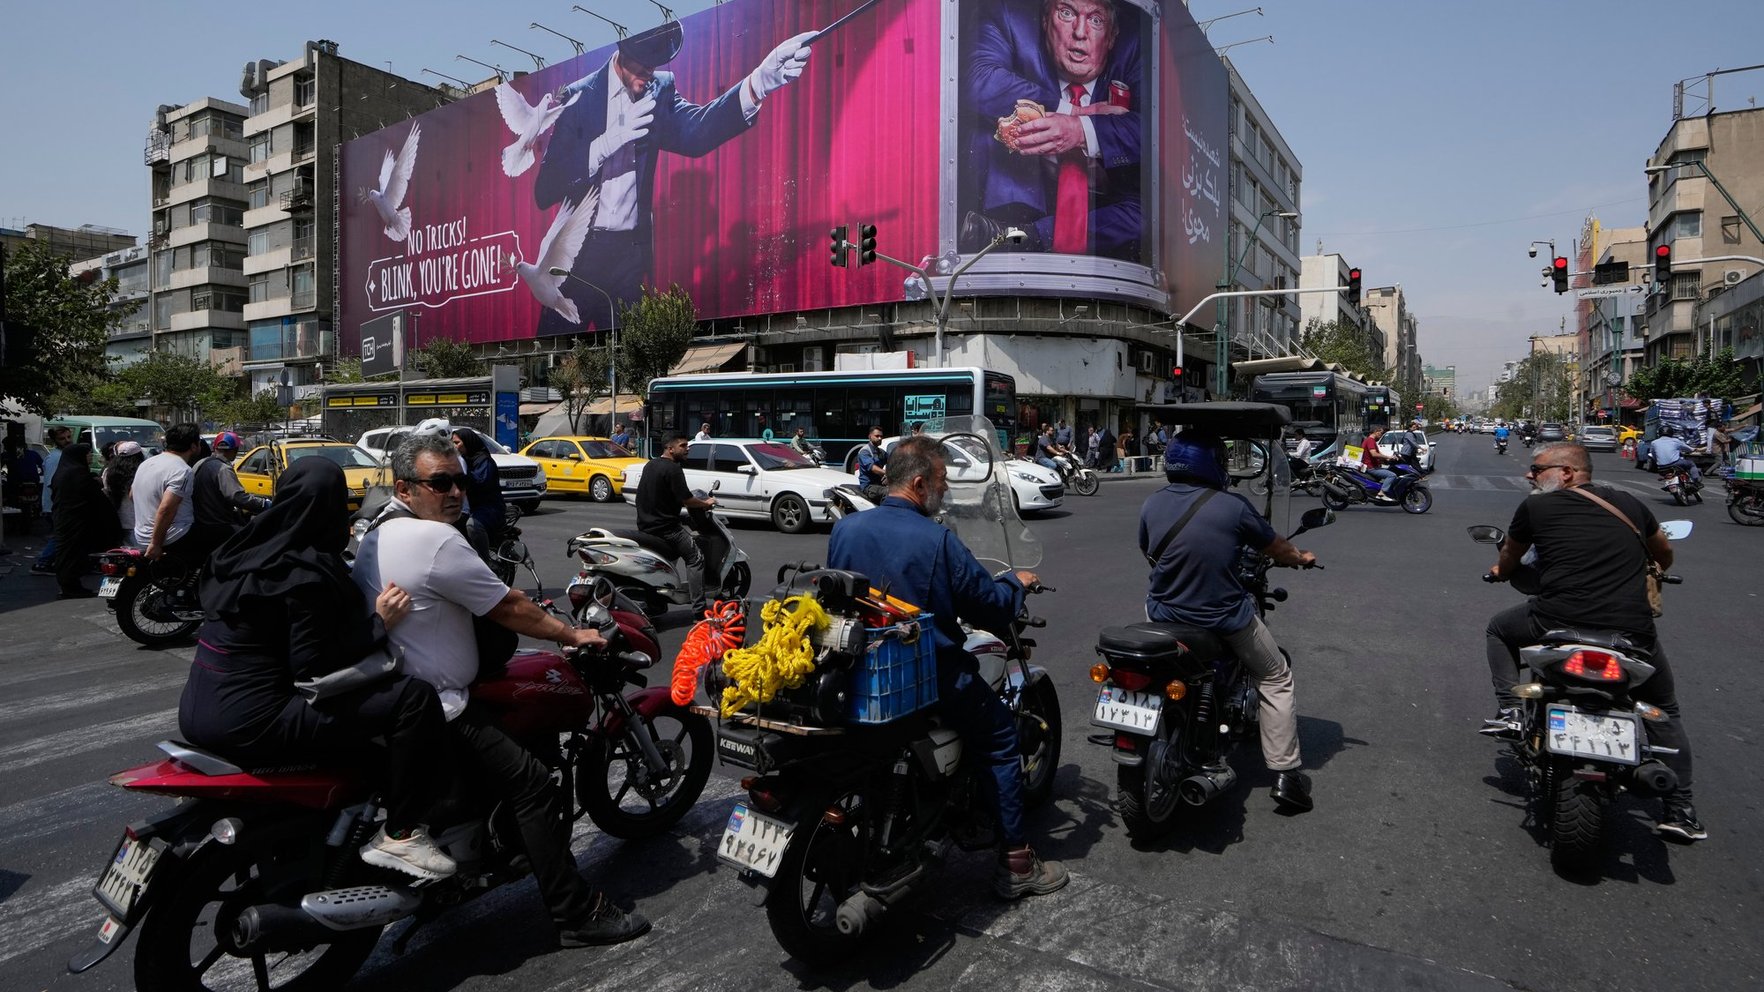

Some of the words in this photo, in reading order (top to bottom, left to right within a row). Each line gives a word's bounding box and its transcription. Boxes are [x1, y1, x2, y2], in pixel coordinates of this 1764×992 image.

[407, 229, 423, 257] NO
[426, 215, 467, 252] TRICKS!
[381, 262, 417, 302] BLINK,
[419, 253, 458, 296] YOU'RE
[461, 244, 501, 289] GONE!
[719, 737, 755, 756] KEEWAY
